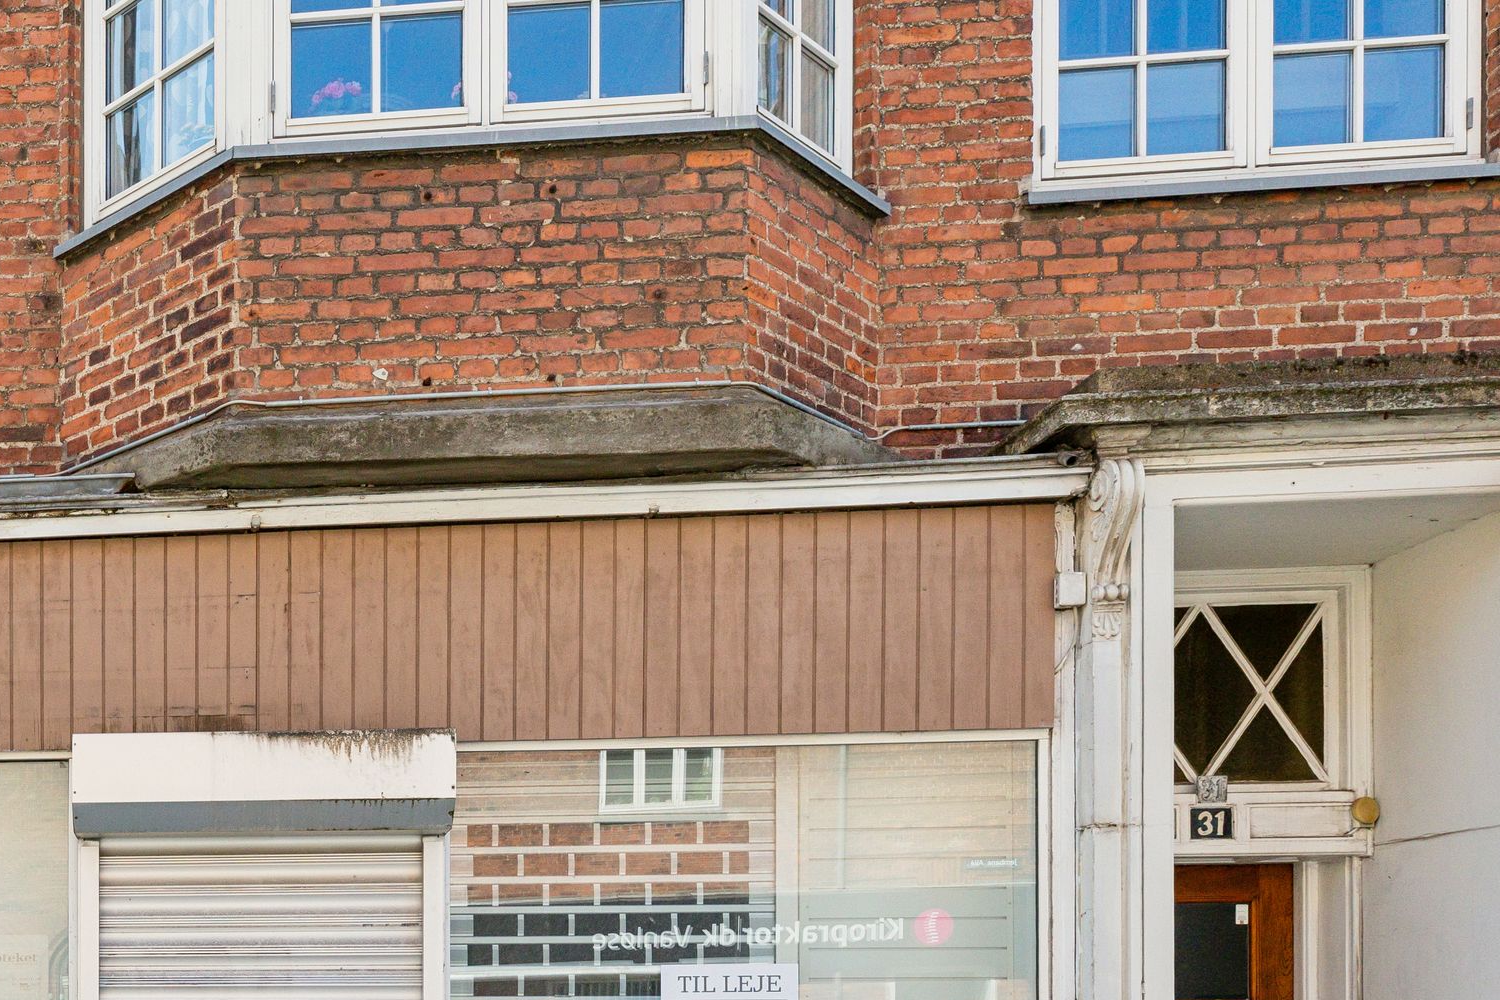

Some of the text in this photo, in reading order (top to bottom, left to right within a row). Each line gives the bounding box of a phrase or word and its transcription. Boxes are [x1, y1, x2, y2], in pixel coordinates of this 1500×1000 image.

[1197, 811, 1225, 836] 31
[677, 974, 782, 993] TIL LEJE
